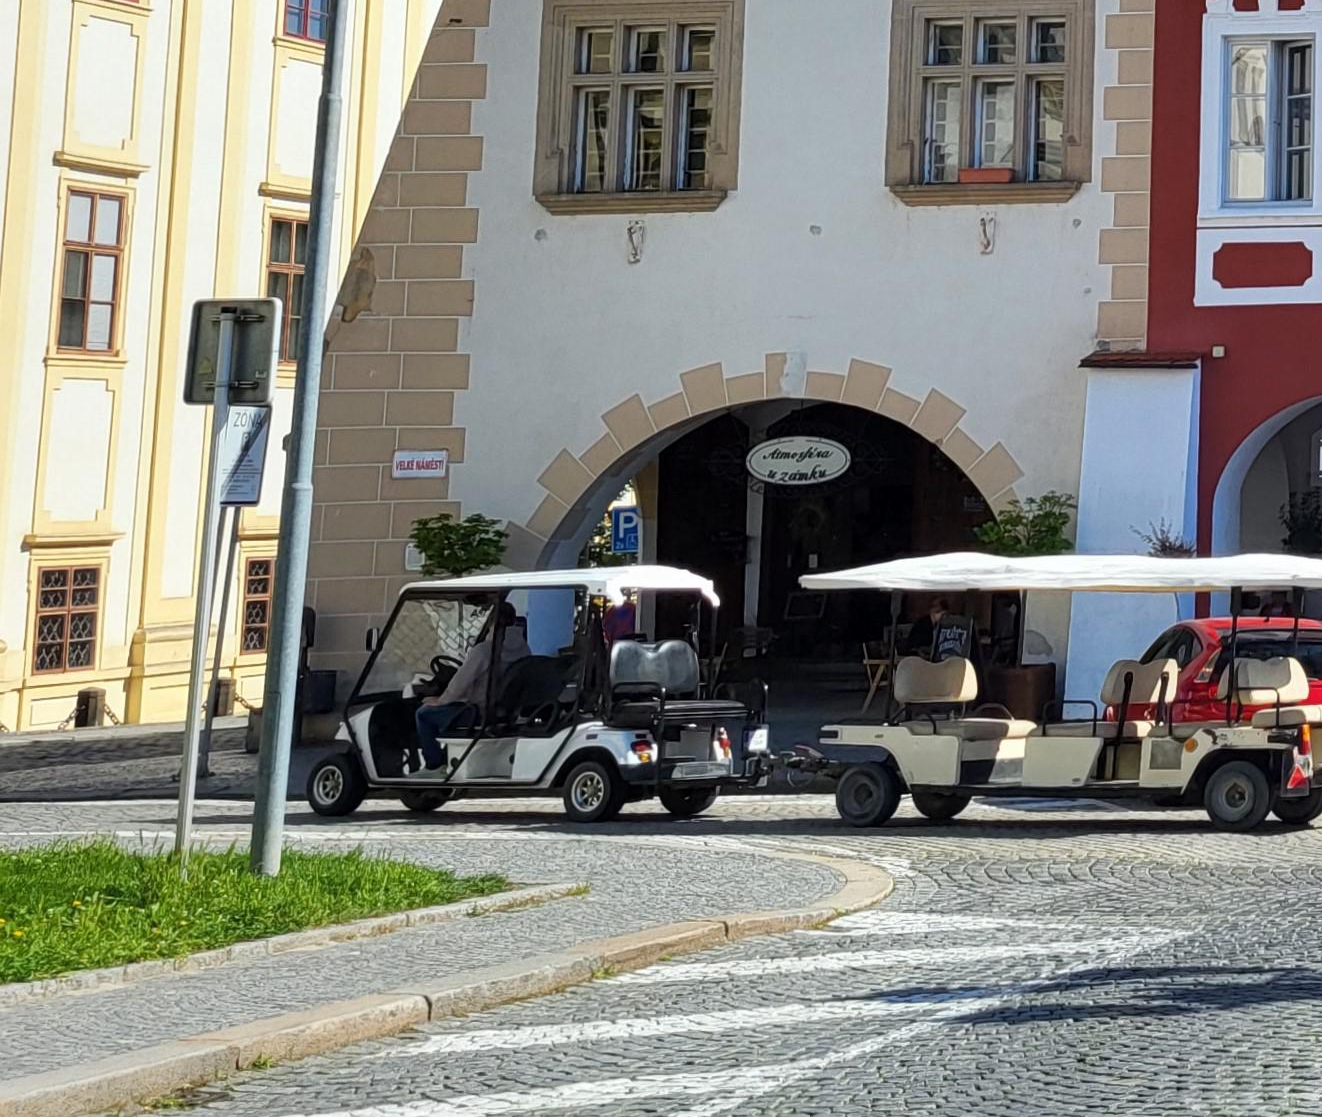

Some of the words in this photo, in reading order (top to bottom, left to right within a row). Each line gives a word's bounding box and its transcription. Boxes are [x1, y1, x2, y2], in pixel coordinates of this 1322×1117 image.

[763, 446, 834, 463] Atmosféra
[396, 458, 414, 471] VELKÉ
[767, 469, 777, 479] u
[619, 512, 636, 538] P
